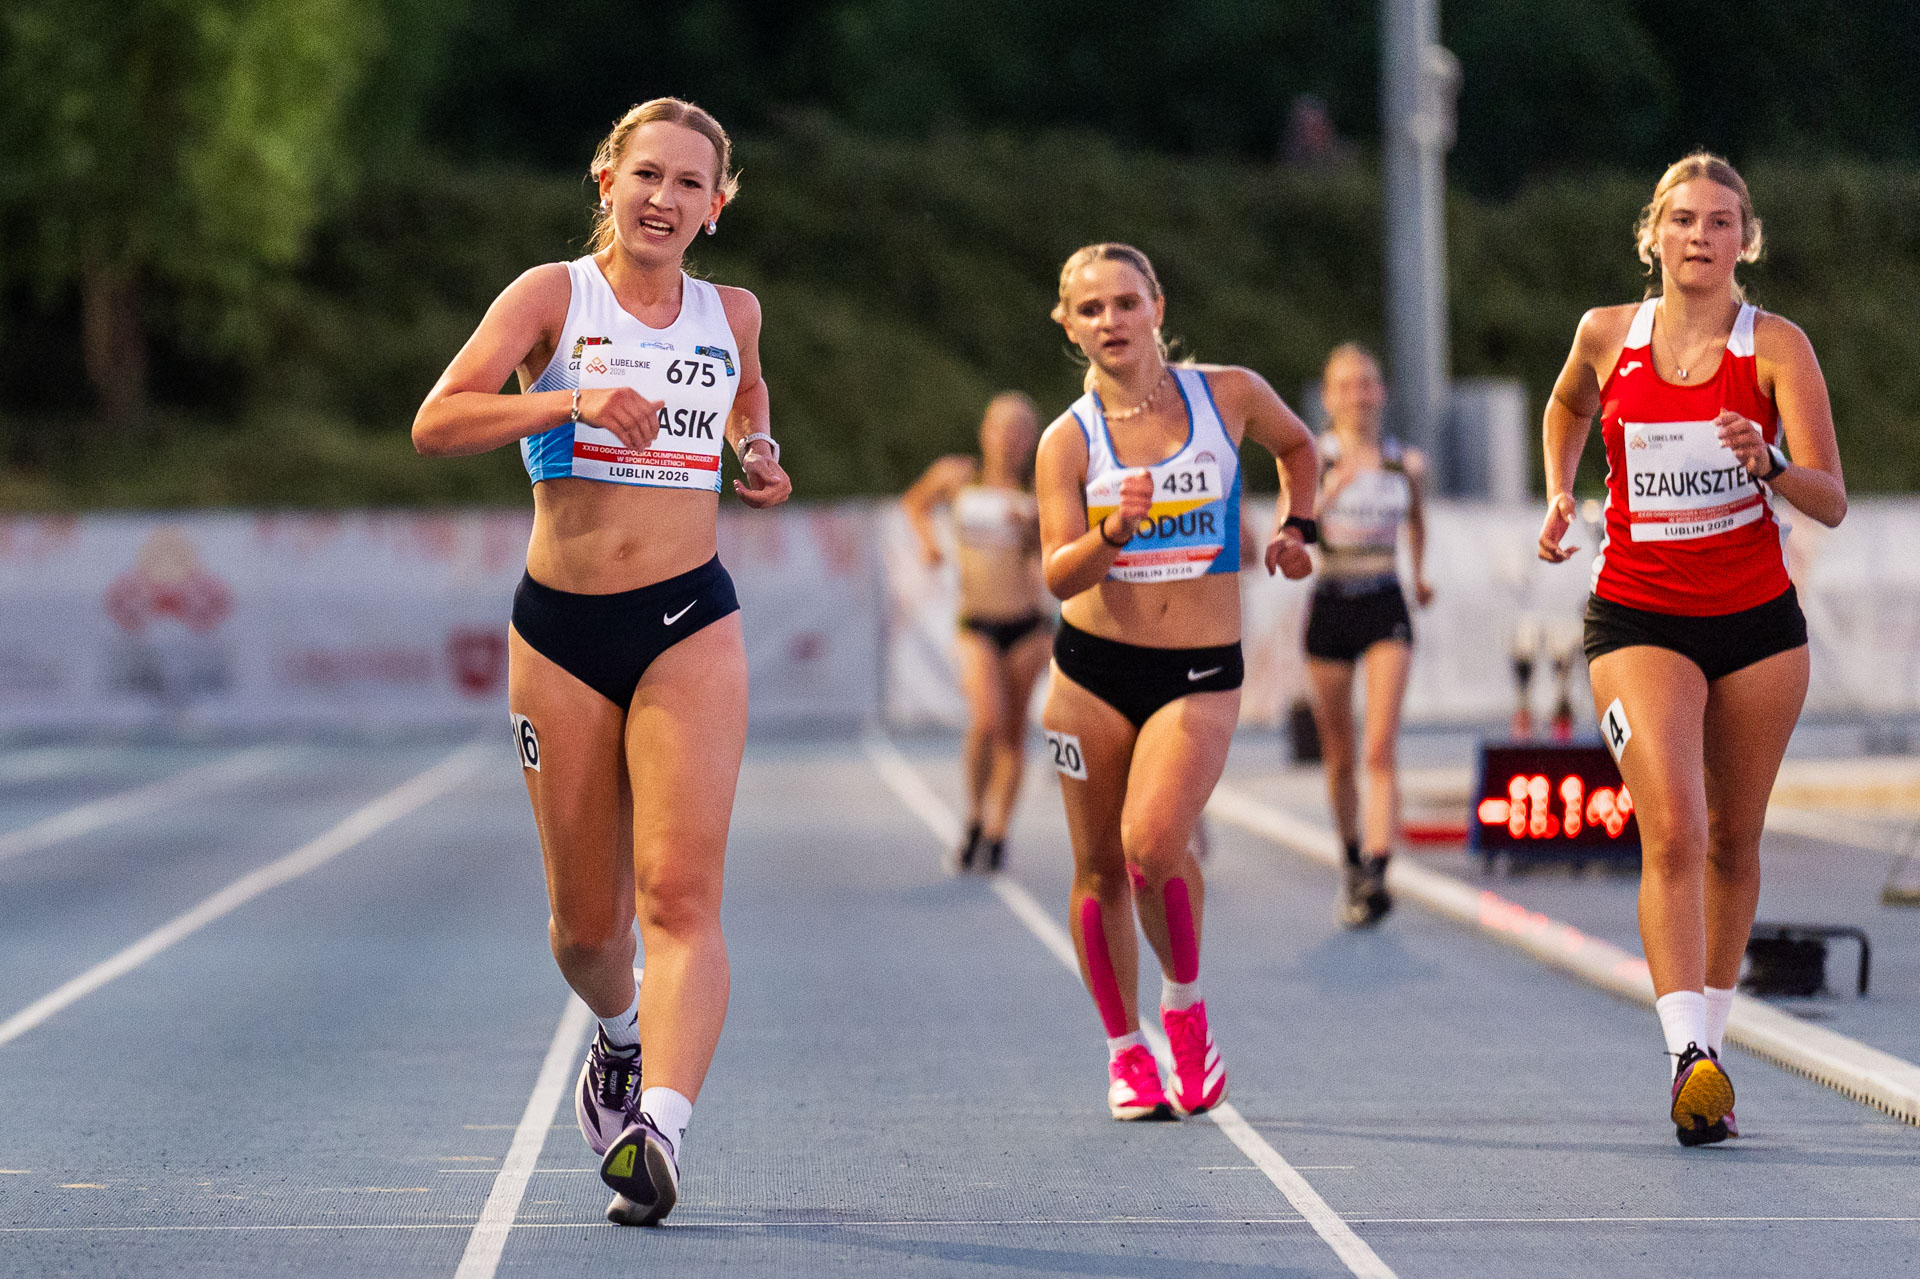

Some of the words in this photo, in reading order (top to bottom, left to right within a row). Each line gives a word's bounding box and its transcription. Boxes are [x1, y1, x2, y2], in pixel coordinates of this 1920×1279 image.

[610, 358, 651, 369] LUBELSKIE
[610, 368, 626, 376] 2026
[666, 360, 716, 387] 675
[658, 407, 718, 439] ASIK
[625, 457, 660, 465] SPORTACH
[660, 459, 686, 467] LETNICH
[652, 451, 685, 460] OLIMPIADA
[609, 466, 655, 480] LUBLIN
[657, 470, 689, 482] 2026
[1162, 471, 1209, 494] 431
[1136, 511, 1216, 540] ODUR
[1665, 525, 1704, 536] LUBLIN
[1123, 570, 1162, 579] LUBLIN
[1609, 710, 1625, 748] 4
[1049, 738, 1081, 772] 20
